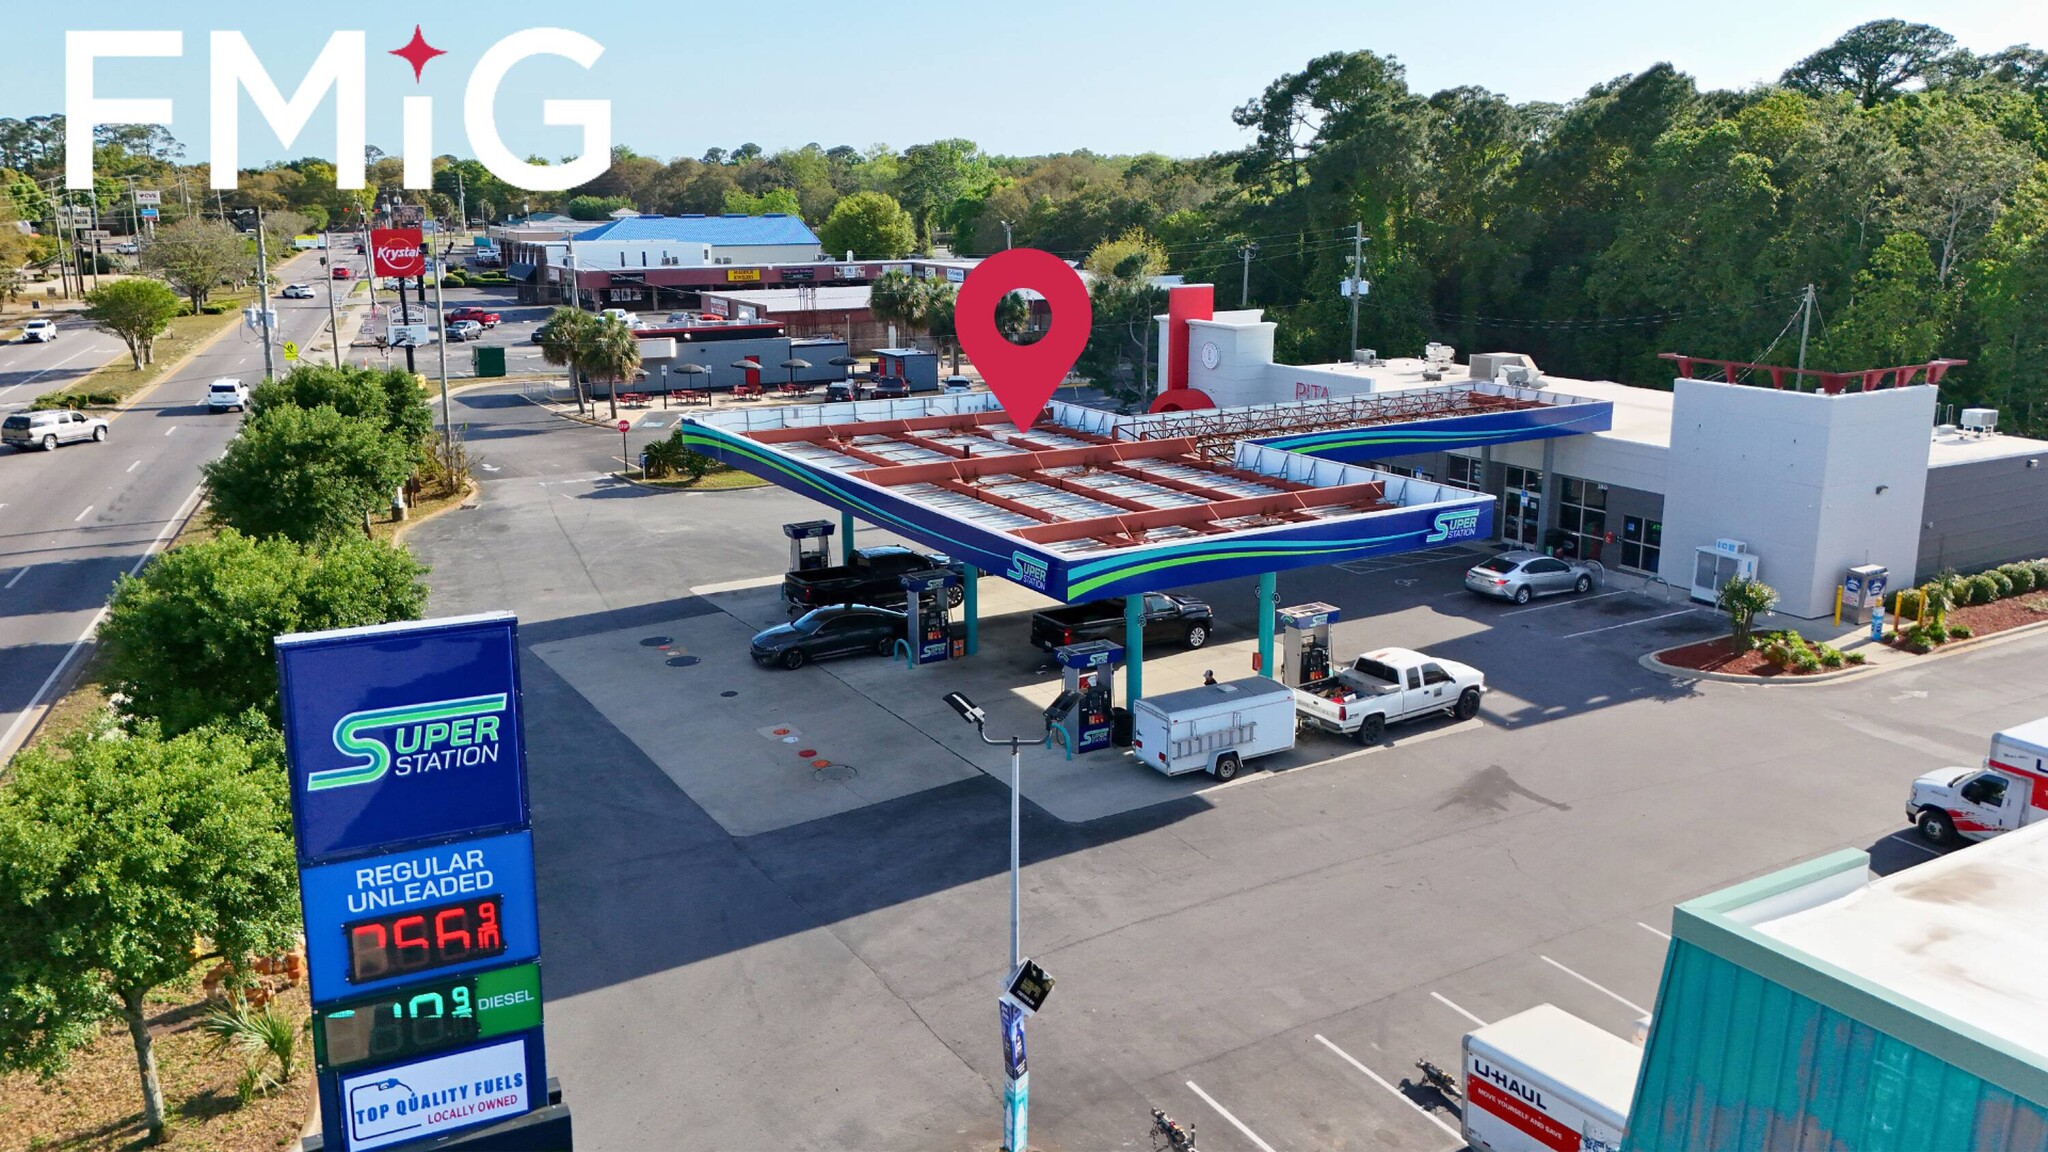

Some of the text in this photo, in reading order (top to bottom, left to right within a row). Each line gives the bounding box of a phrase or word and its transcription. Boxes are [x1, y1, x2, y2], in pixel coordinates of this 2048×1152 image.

[377, 246, 420, 261] Krystal
[1296, 382, 1329, 400] PITA
[1426, 509, 1480, 542] SUPER
[1448, 528, 1476, 539] STATION
[1007, 550, 1048, 582] SUPER
[1023, 574, 1046, 590] STATION
[307, 692, 507, 791] SUPER
[395, 743, 499, 776] STATION
[356, 849, 485, 889] REGULAR
[347, 869, 495, 913] UNLEADED
[478, 989, 535, 1011] DIESEL
[356, 1072, 523, 1125] TOP QUALITY FUELS
[1474, 1059, 1547, 1111] U-HAUL
[428, 1094, 518, 1125] LOCALLY OWNED
[1477, 1087, 1563, 1140] MOVE YOURSELF AND SAVE
